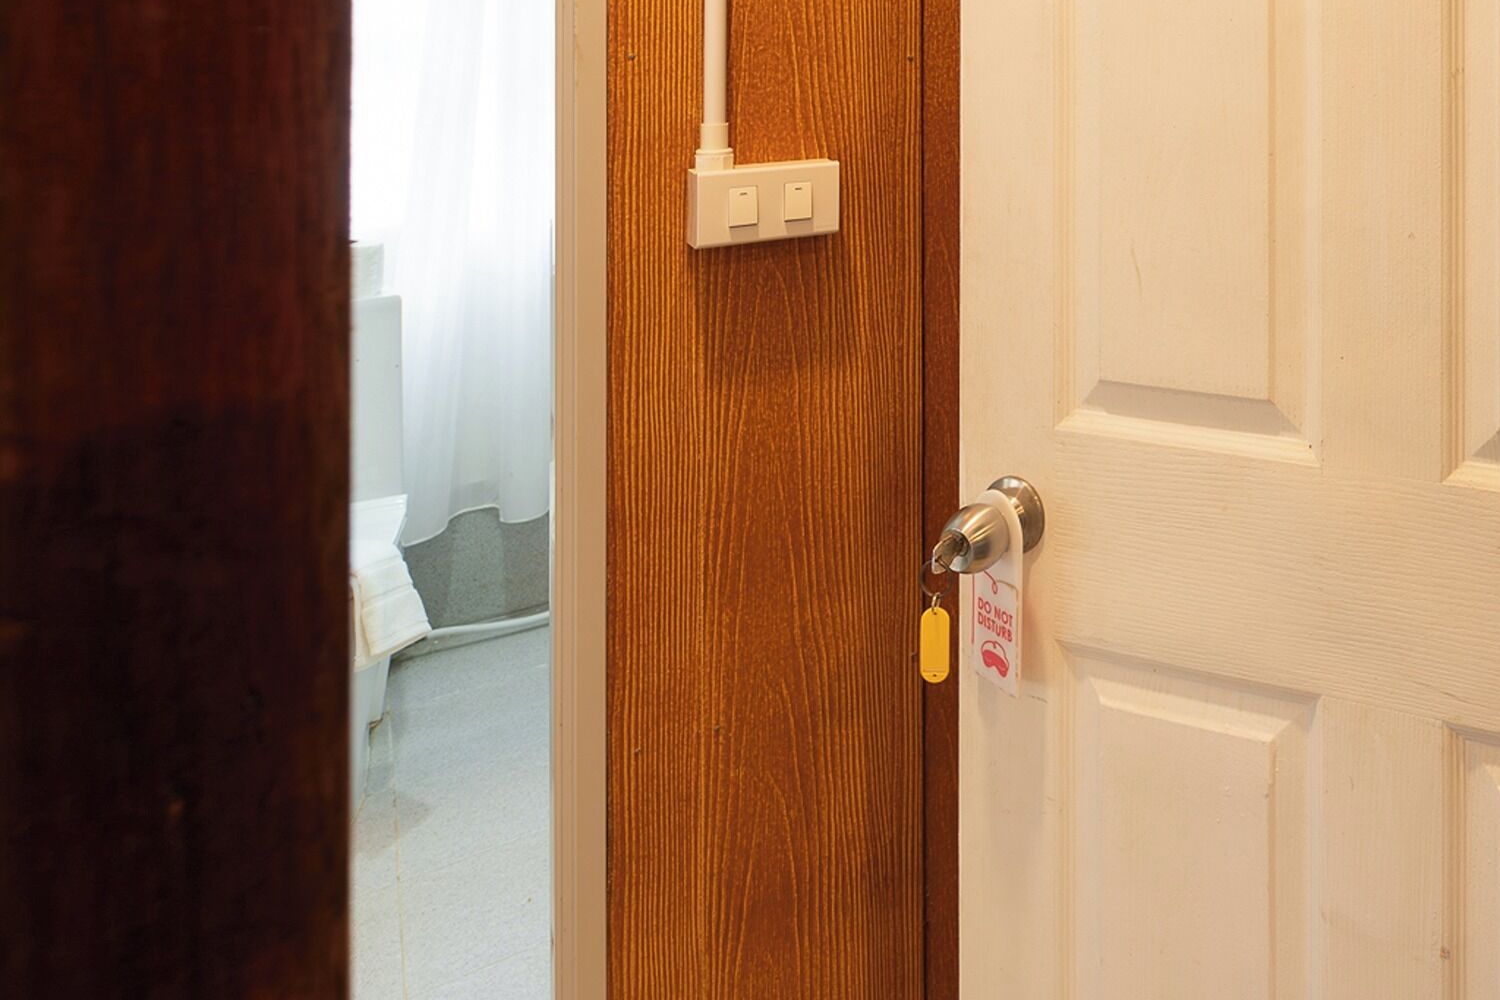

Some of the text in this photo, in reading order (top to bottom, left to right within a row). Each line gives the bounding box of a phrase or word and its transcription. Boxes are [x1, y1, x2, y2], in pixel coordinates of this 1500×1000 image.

[977, 596, 1013, 627] DO NOT
[977, 611, 1013, 642] DISTURB
